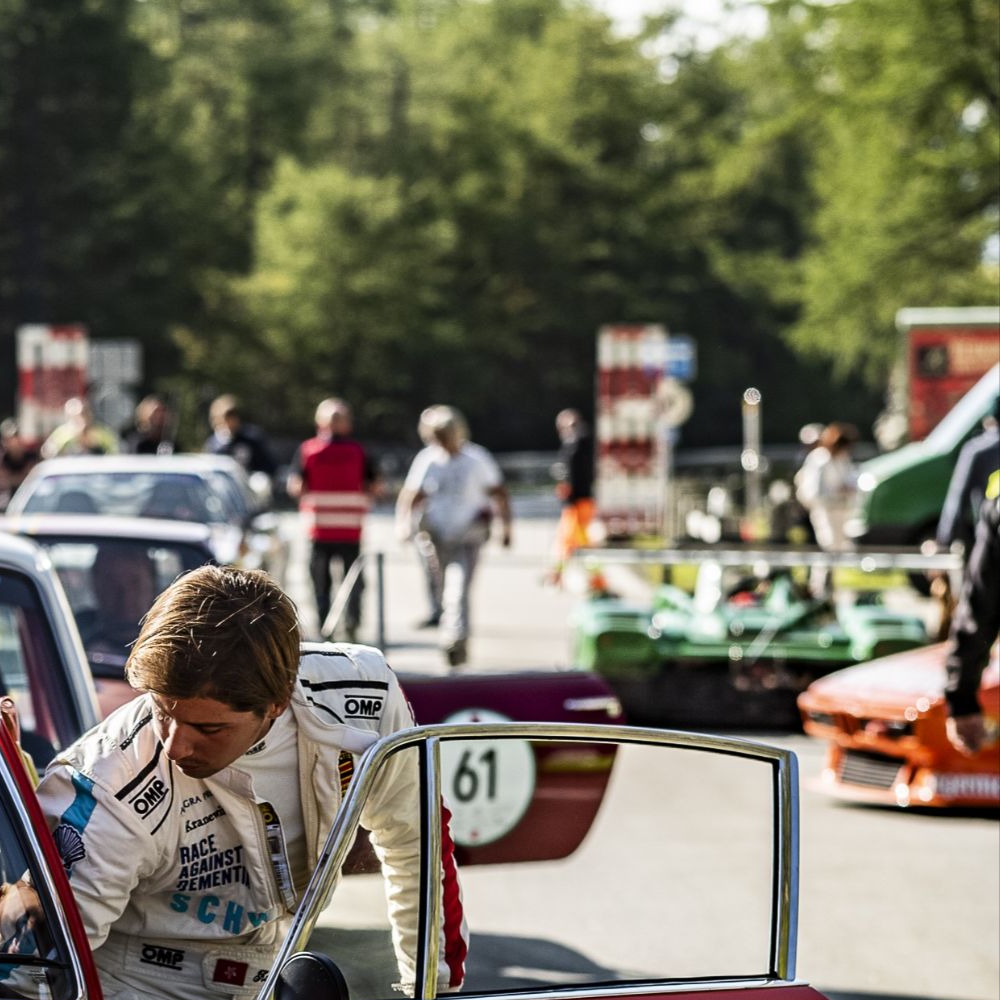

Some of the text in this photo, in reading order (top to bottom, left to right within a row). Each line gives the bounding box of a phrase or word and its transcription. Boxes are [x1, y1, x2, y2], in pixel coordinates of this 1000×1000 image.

[344, 698, 382, 716] OMP
[453, 748, 497, 803] 61
[134, 779, 165, 815] OMP
[178, 844, 244, 880] AGAINST
[179, 833, 218, 865] RACE
[142, 947, 185, 967] OMP
